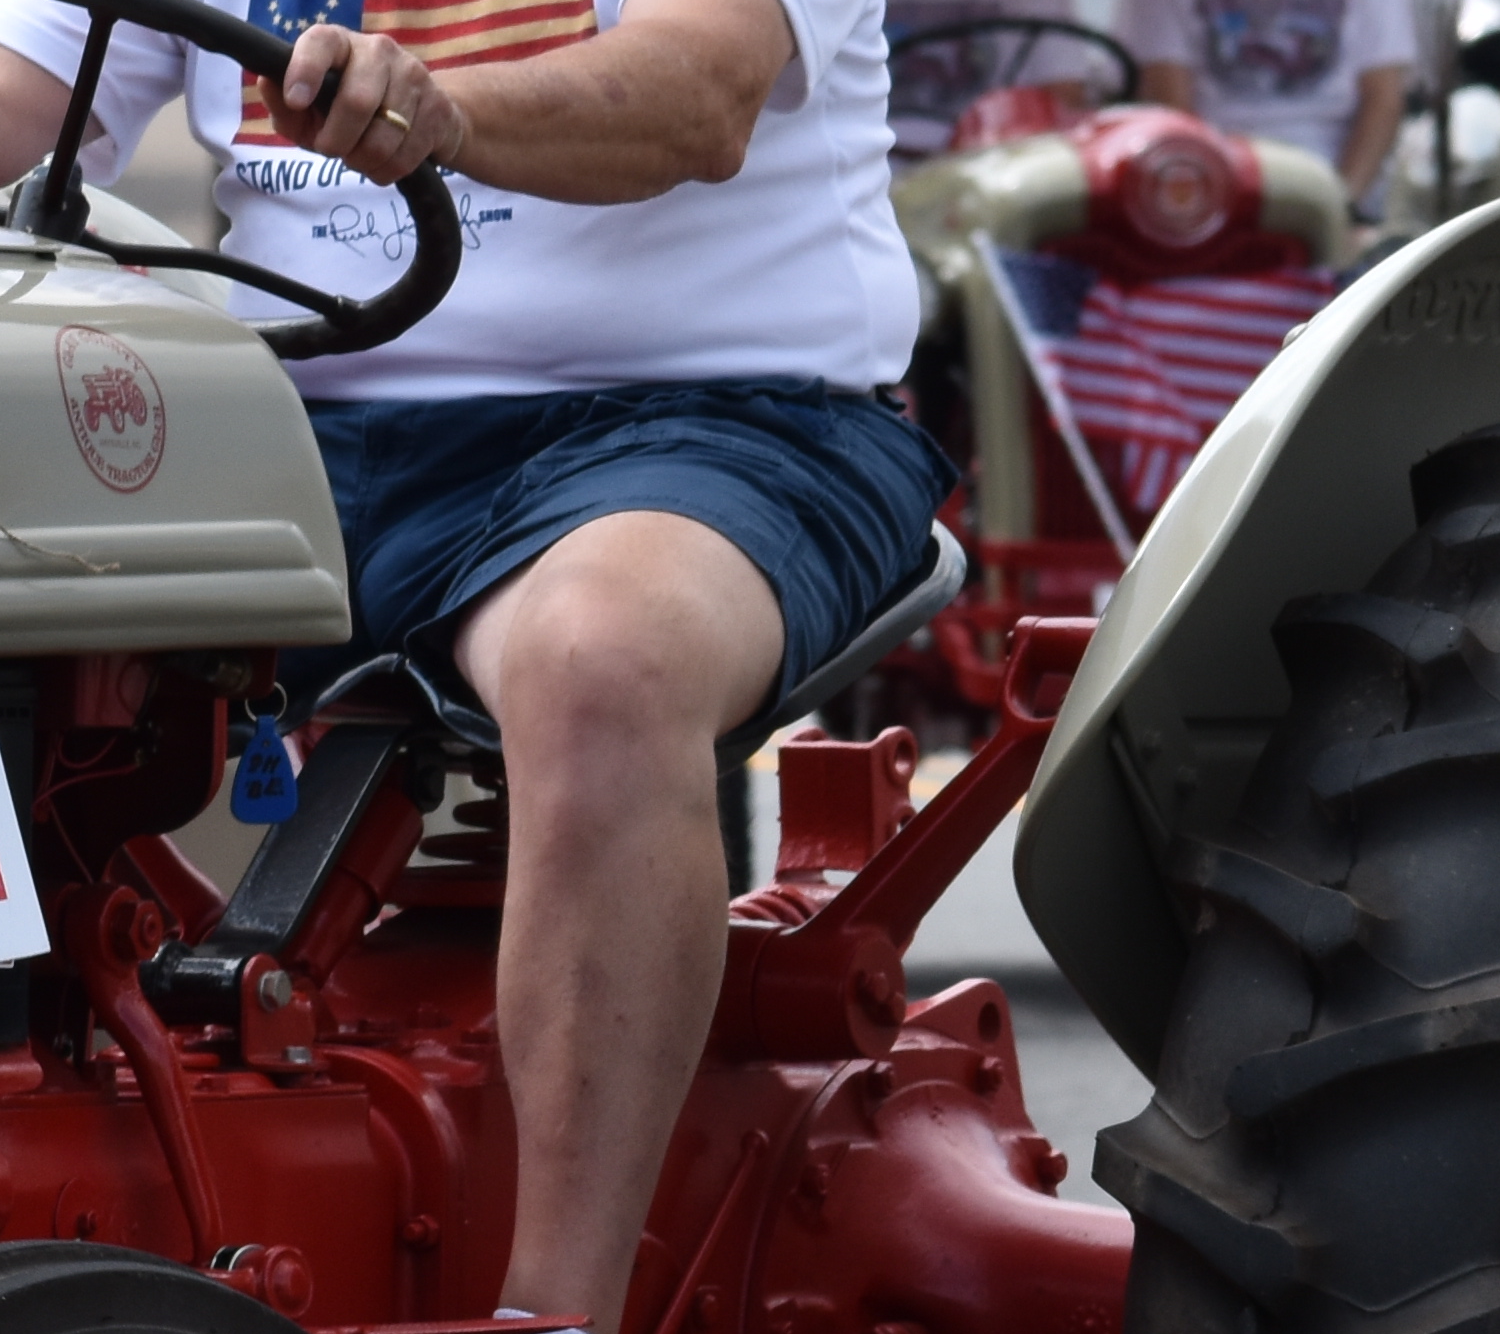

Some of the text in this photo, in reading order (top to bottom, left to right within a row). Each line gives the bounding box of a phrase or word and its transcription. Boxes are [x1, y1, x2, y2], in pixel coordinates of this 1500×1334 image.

[236, 159, 314, 194] STAND
[312, 224, 327, 239] THE
[479, 207, 513, 223] SHOW
[106, 452, 155, 484] TRACTOR
